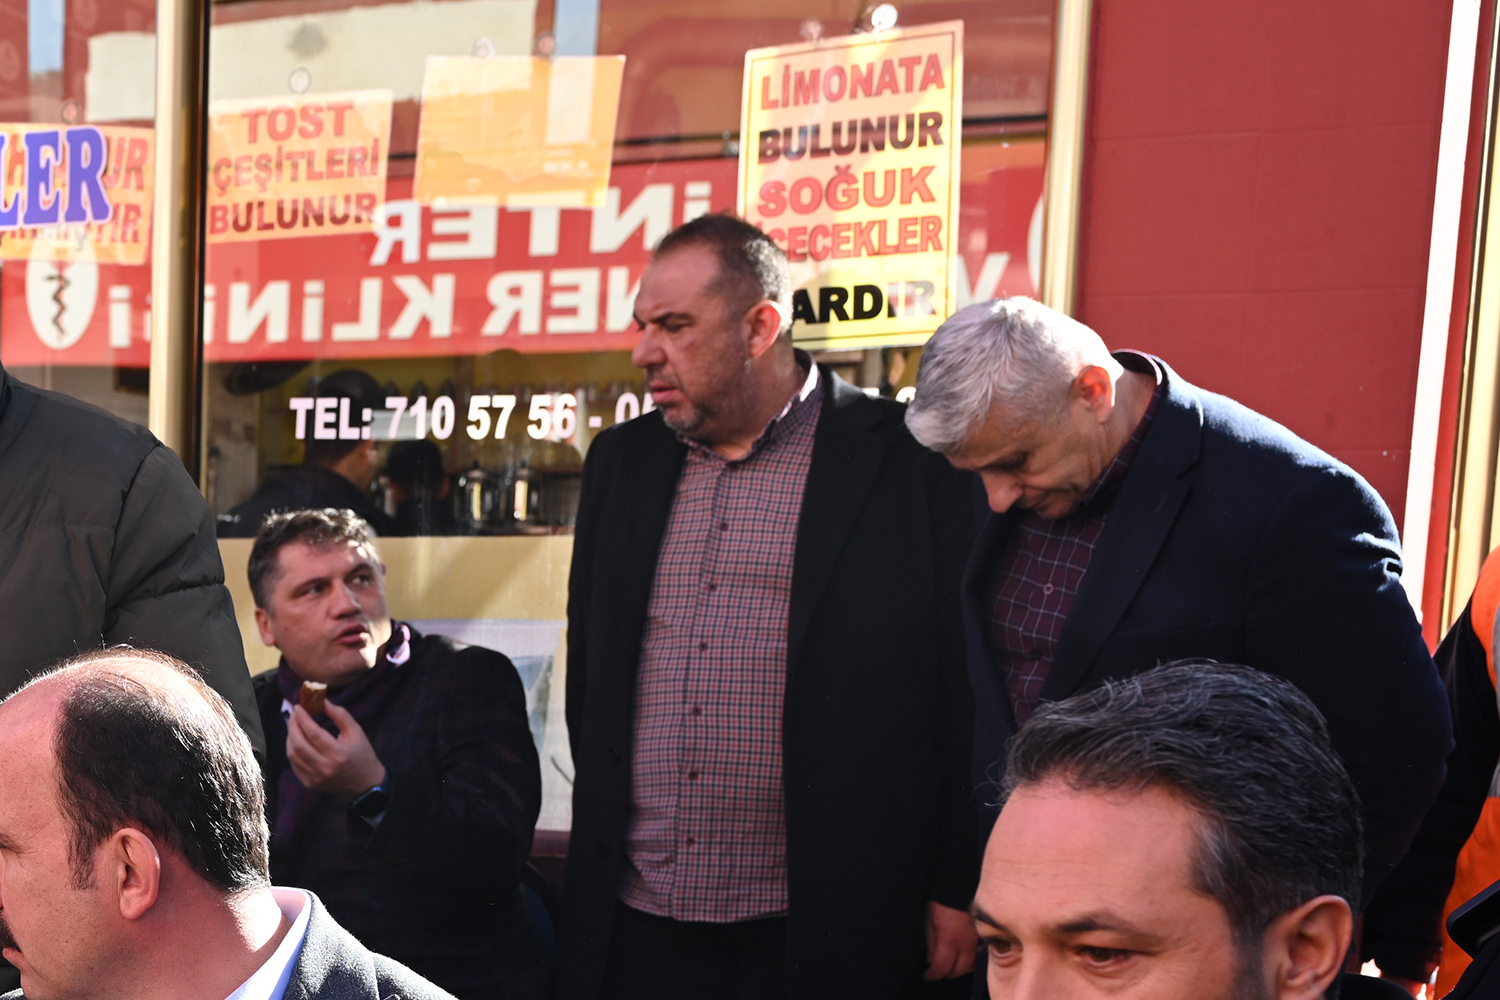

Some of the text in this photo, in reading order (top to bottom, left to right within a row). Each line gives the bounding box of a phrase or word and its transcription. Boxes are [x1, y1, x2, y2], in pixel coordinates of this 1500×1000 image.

[761, 54, 945, 110] LİMONATA
[241, 101, 354, 143] TOST
[758, 111, 944, 164] BULUNUR
[213, 138, 380, 197] ÇEŞİTLERİ
[757, 164, 936, 218] SOĞUK
[209, 191, 380, 235] BULUNUR
[757, 215, 943, 263] ECEKLER
[793, 279, 936, 324] ARDIR
[289, 397, 373, 440] TEL:
[385, 396, 455, 440] 710
[466, 394, 516, 440] 57
[527, 393, 577, 440] 56
